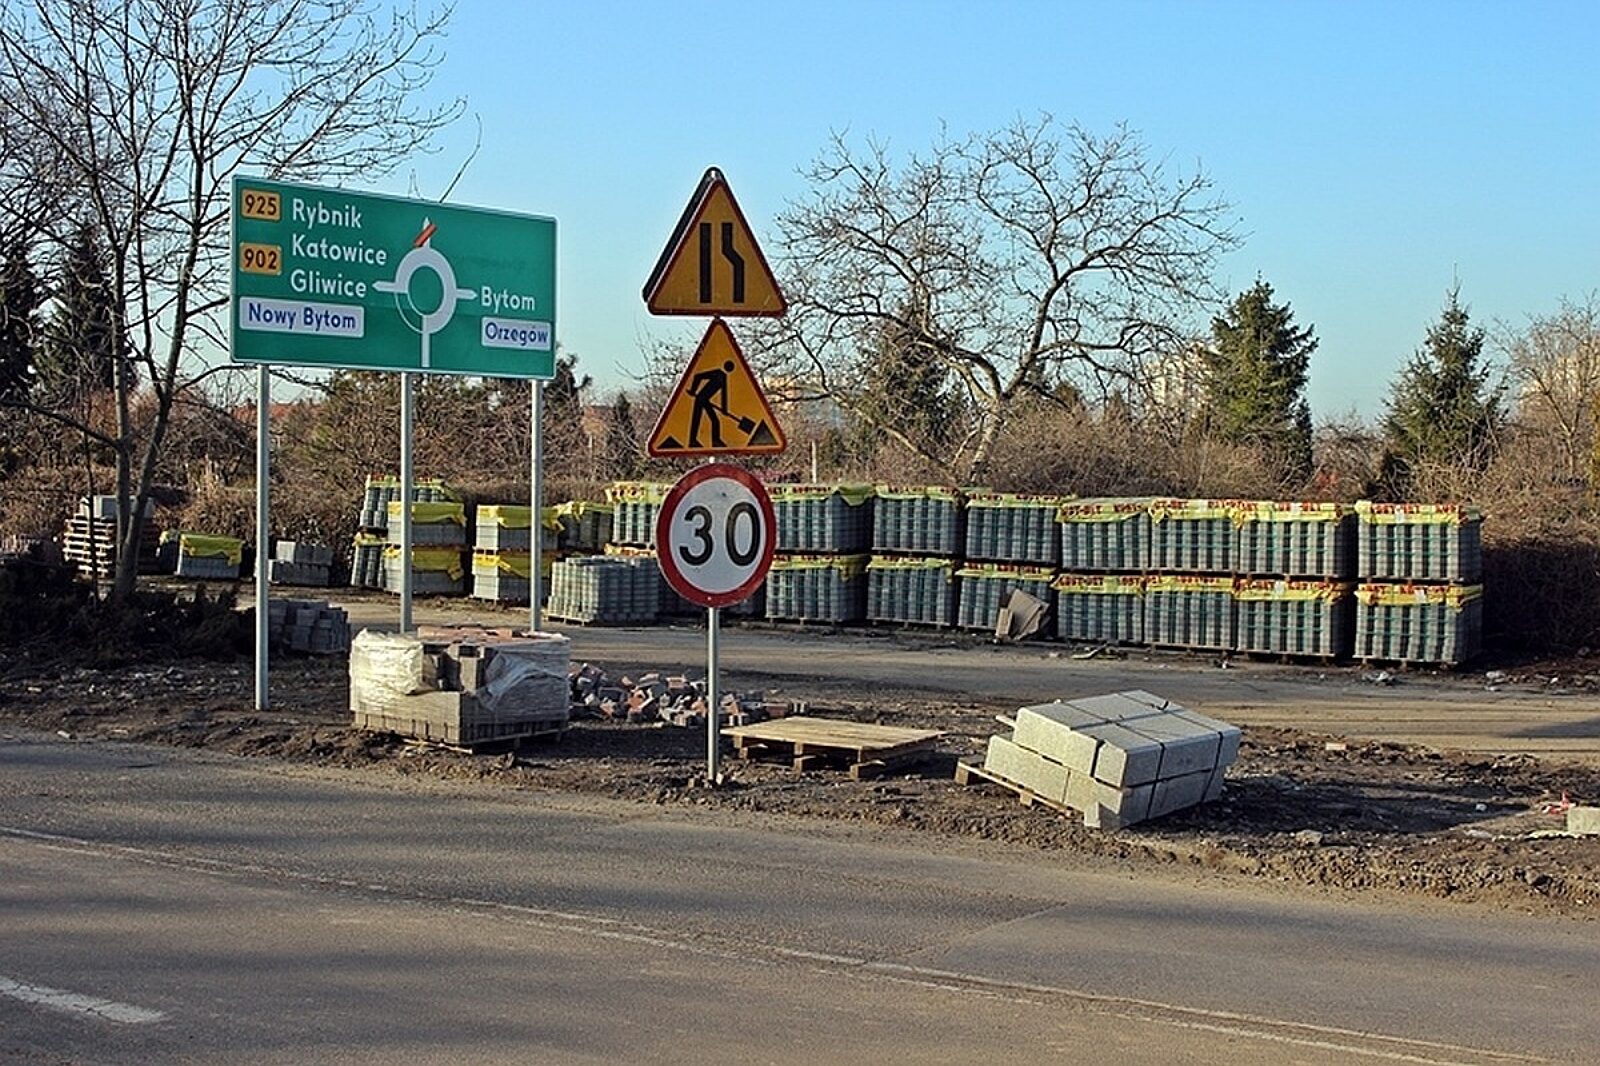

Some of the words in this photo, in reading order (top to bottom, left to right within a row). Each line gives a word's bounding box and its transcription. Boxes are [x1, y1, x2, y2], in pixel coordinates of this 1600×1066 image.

[244, 194, 278, 216] 925
[292, 198, 362, 228] Rybnik
[243, 249, 278, 270] 902
[292, 234, 387, 266] Katowice
[290, 270, 367, 298] Gliwice
[481, 286, 536, 313] Bytom
[248, 302, 297, 329] Nowy
[303, 312, 356, 332] Bytom
[679, 501, 761, 566] 30
